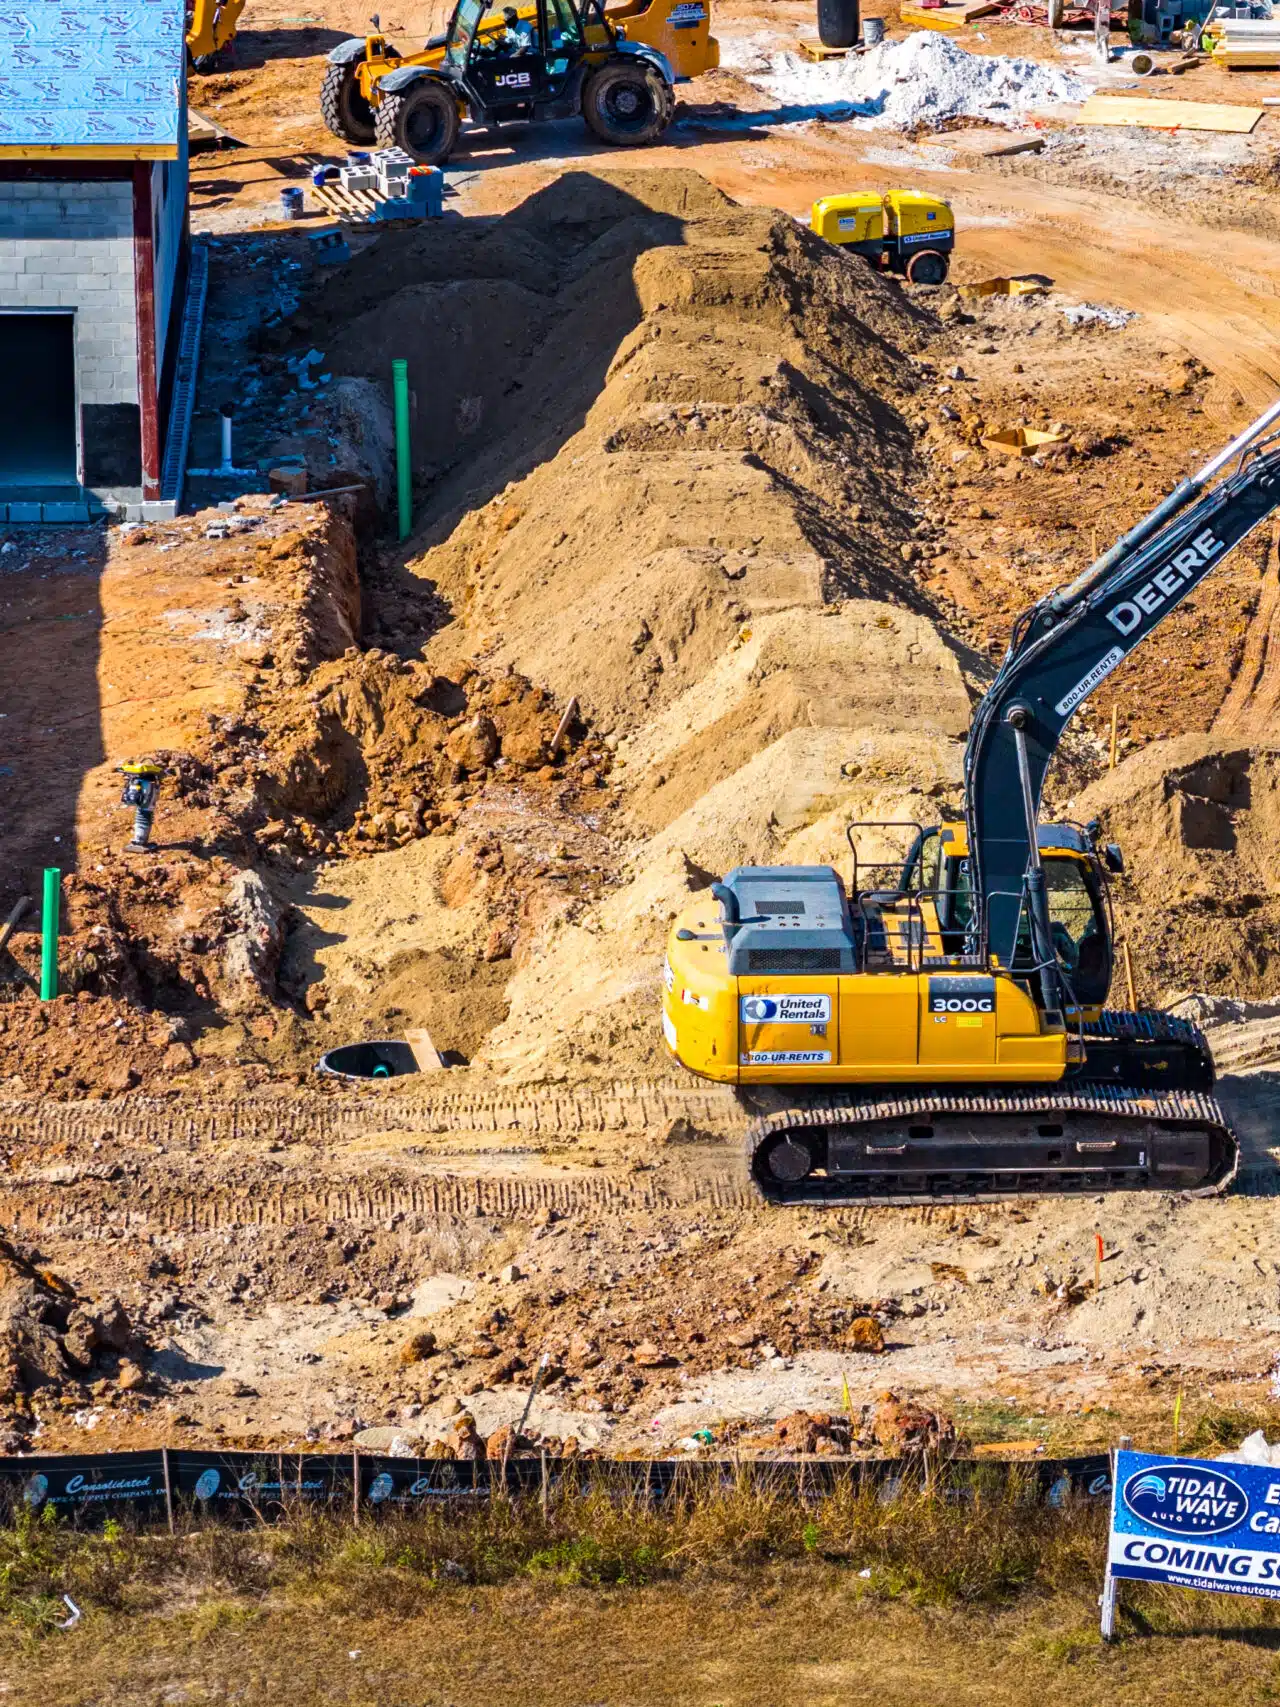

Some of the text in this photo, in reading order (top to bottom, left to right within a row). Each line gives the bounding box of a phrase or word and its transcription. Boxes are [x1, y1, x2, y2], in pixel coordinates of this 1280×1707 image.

[495, 73, 531, 86] JCB
[1105, 528, 1225, 636] DEERE
[1062, 653, 1118, 710] 800-UR-RENTS
[779, 999, 823, 1009] United
[933, 998, 992, 1012] 300G
[779, 1009, 826, 1019] Rentals
[65, 1475, 151, 1494] Consolidated
[1167, 1477, 1227, 1499] TIDAL
[1176, 1496, 1239, 1518] WAVE
[1151, 1512, 1216, 1526] AUTO SPA
[1124, 1541, 1252, 1577] COMING
